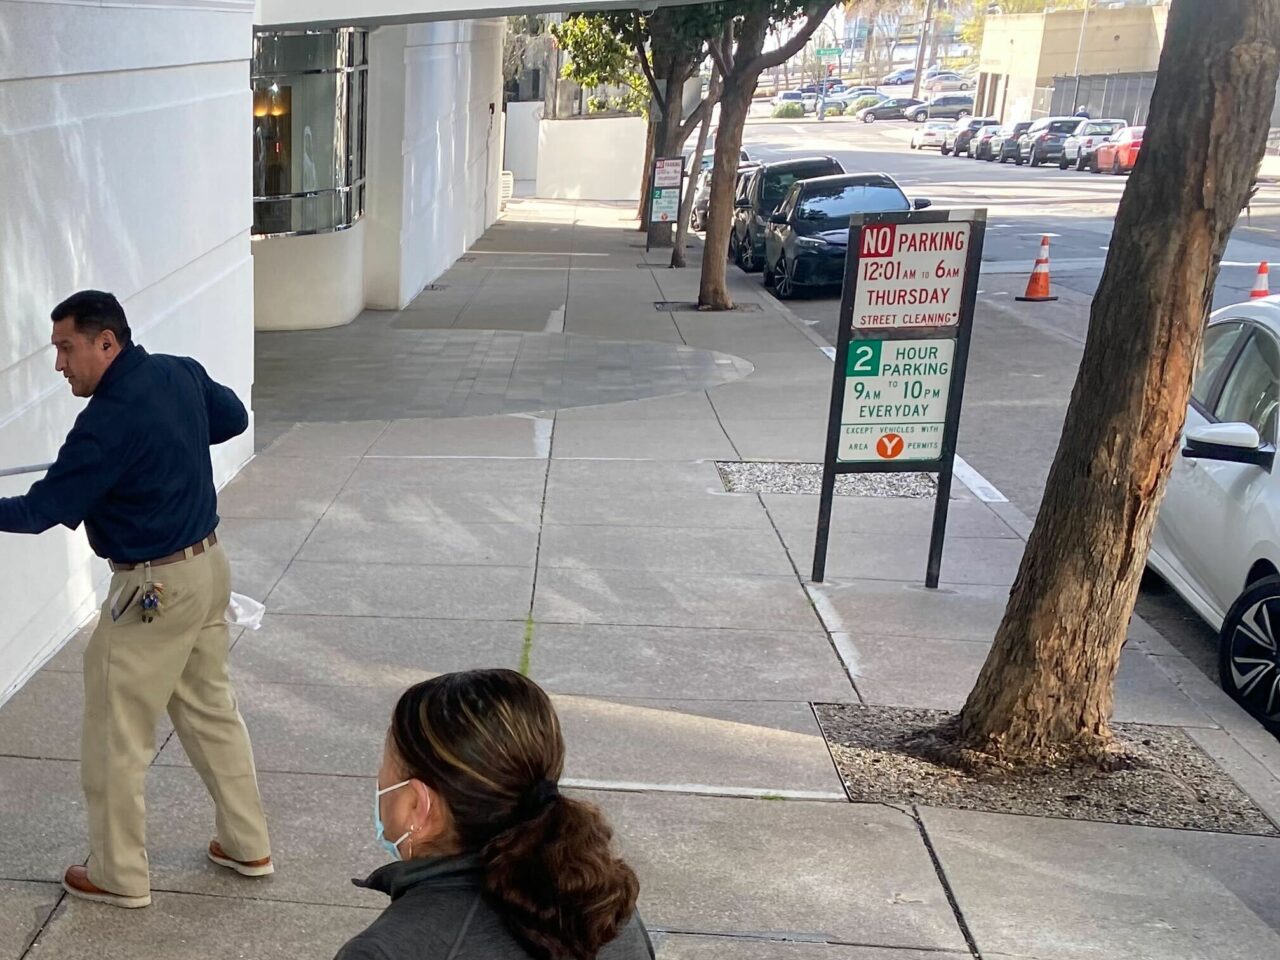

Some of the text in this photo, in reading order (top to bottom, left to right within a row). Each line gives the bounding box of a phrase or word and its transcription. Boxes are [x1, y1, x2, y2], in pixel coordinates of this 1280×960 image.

[655, 190, 661, 198] 2
[862, 226, 965, 255] NO PARKING
[867, 287, 951, 306] THURSDAY
[860, 312, 952, 325] STREET CLEANING
[853, 345, 938, 371] 2 HOUR
[882, 362, 949, 376] PARKING
[888, 380, 899, 388] TO
[859, 404, 929, 418] EVERYDAY
[881, 436, 901, 456] Y
